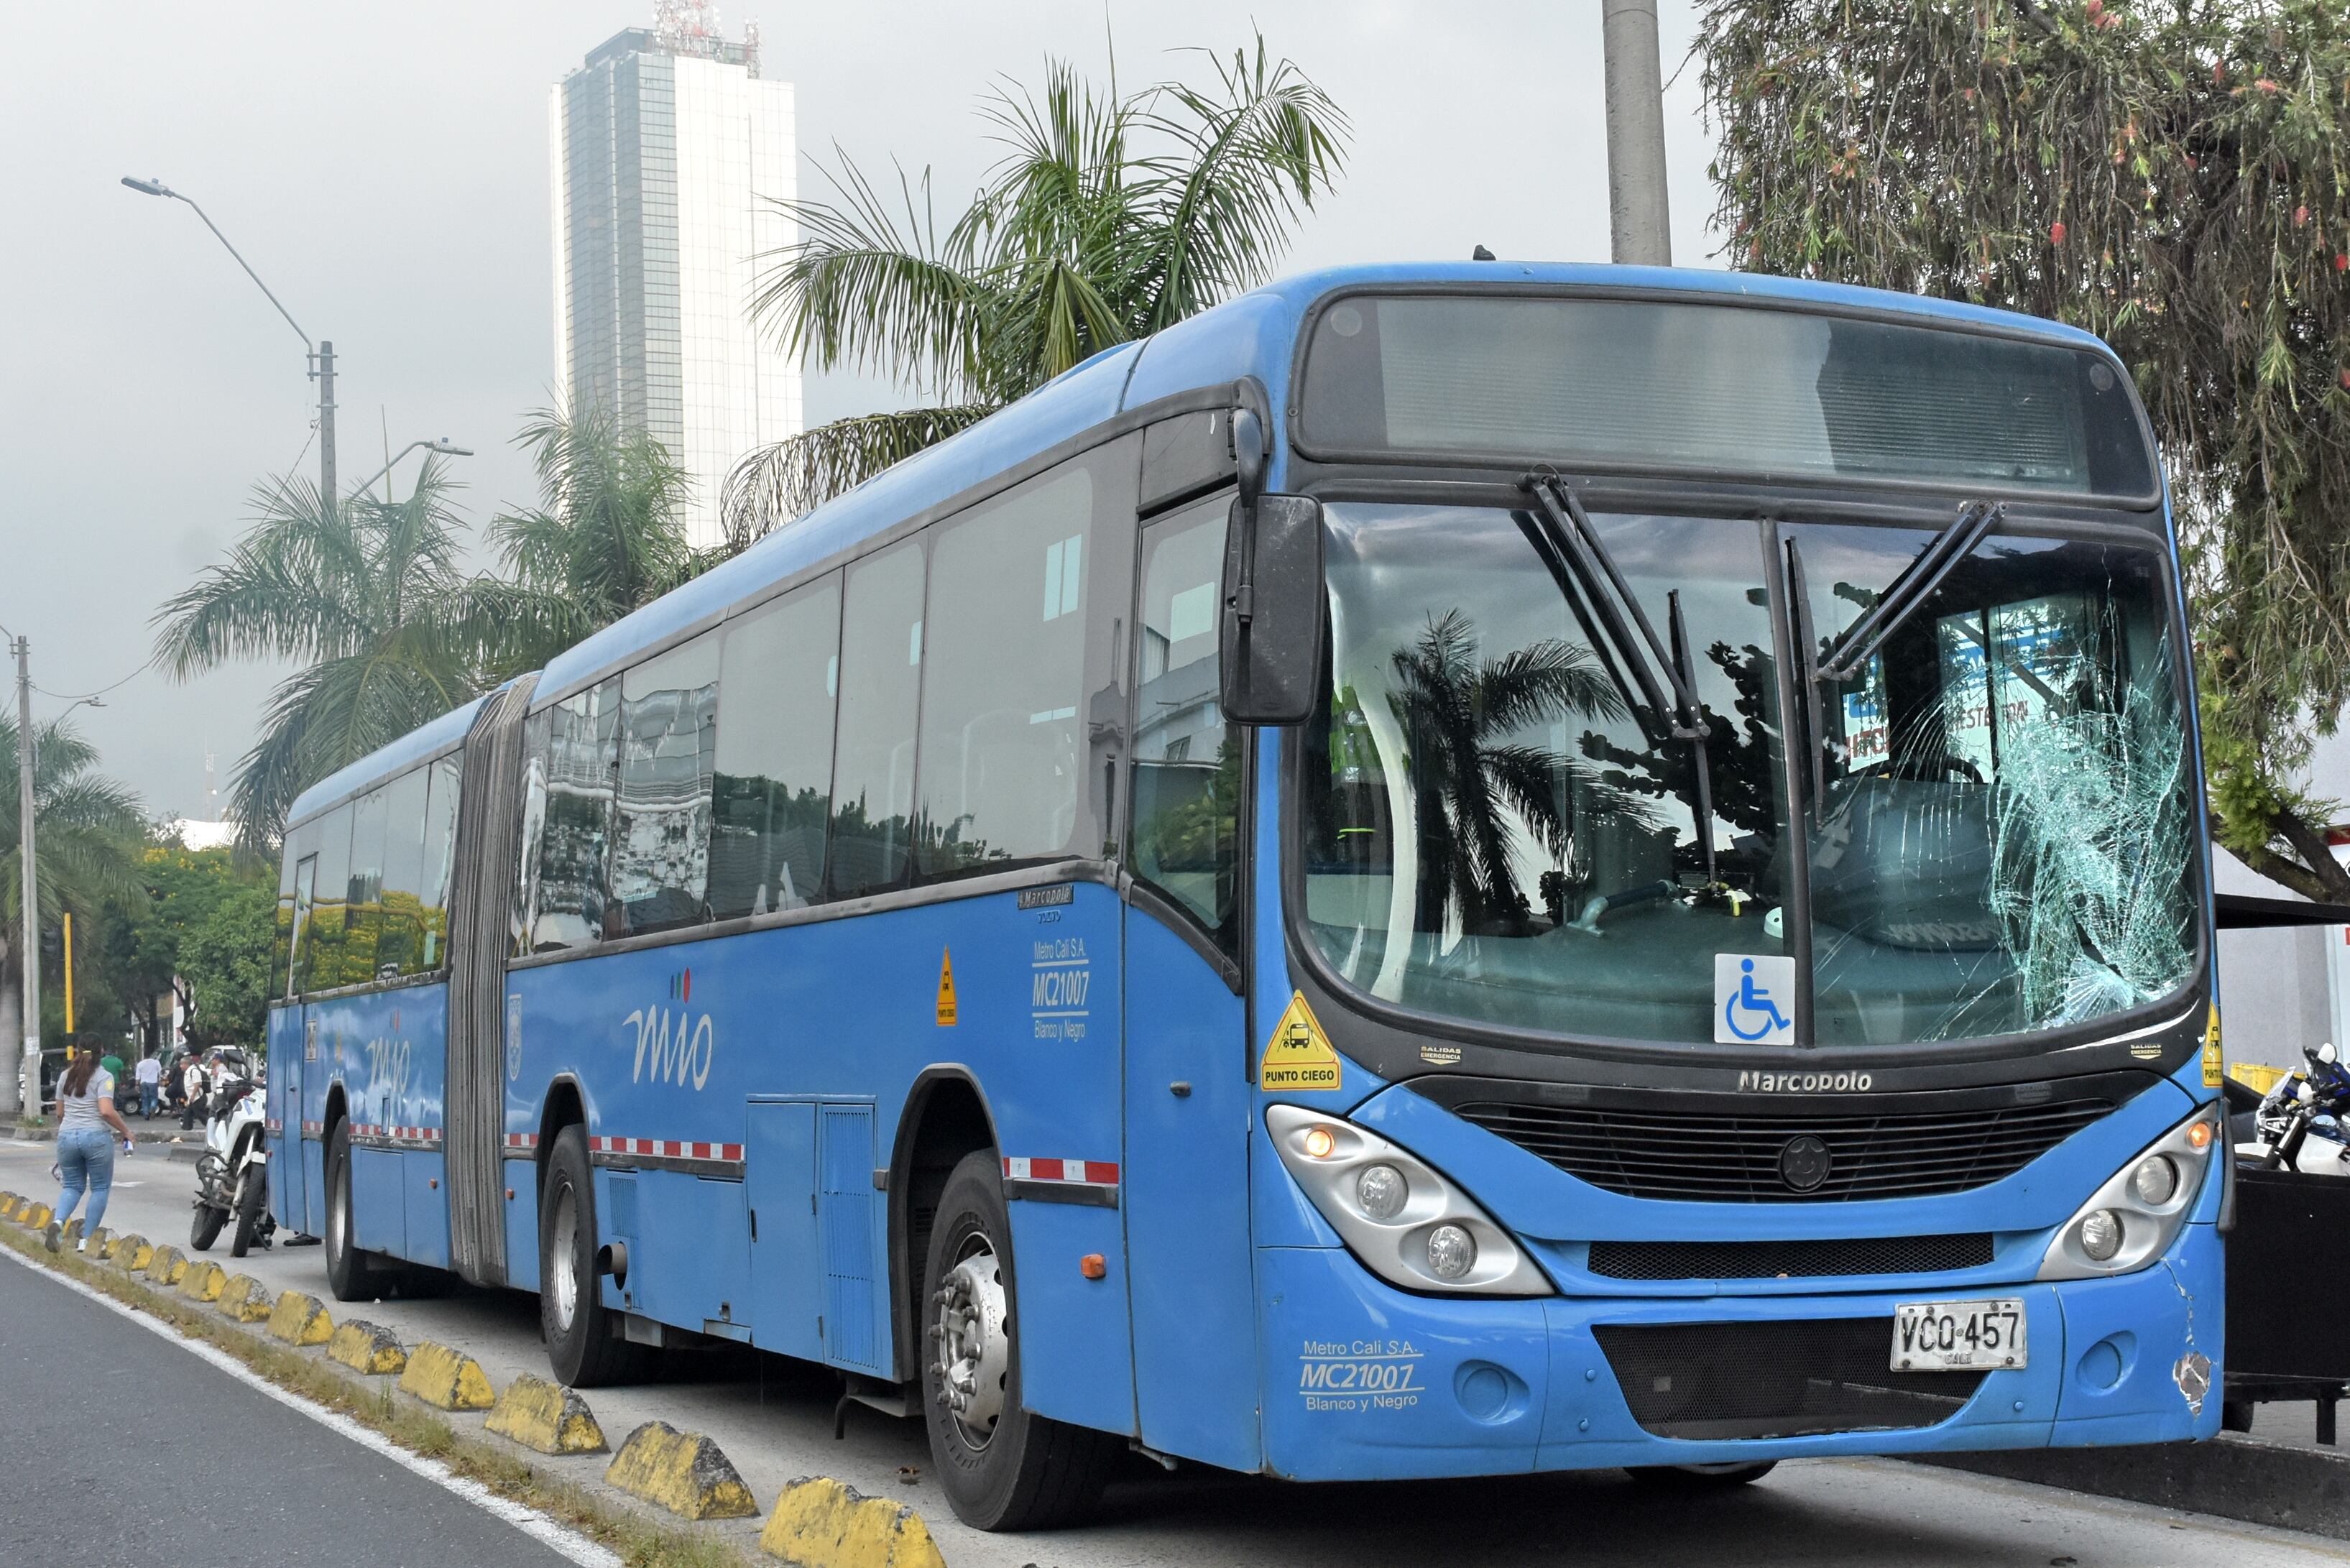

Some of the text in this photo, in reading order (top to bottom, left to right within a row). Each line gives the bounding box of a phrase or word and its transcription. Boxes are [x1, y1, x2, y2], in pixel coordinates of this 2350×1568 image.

[1025, 886, 1070, 905] Marcopolo
[1035, 938, 1086, 959] Metro Cali S.A.
[1033, 971, 1089, 1006] MC21007
[1035, 1019, 1085, 1042] Blanco y Negro
[1420, 1052, 1461, 1061] EMERGENCIA
[1266, 1070, 1335, 1082] PUNTO CIEGO
[1738, 1071, 1872, 1092] Marcopolo
[1965, 1312, 2019, 1350] 457
[1304, 1340, 1418, 1355] Metro Cali S.A.
[1300, 1364, 1414, 1391] MC21007
[1306, 1395, 1418, 1413] Blanco y Negro
